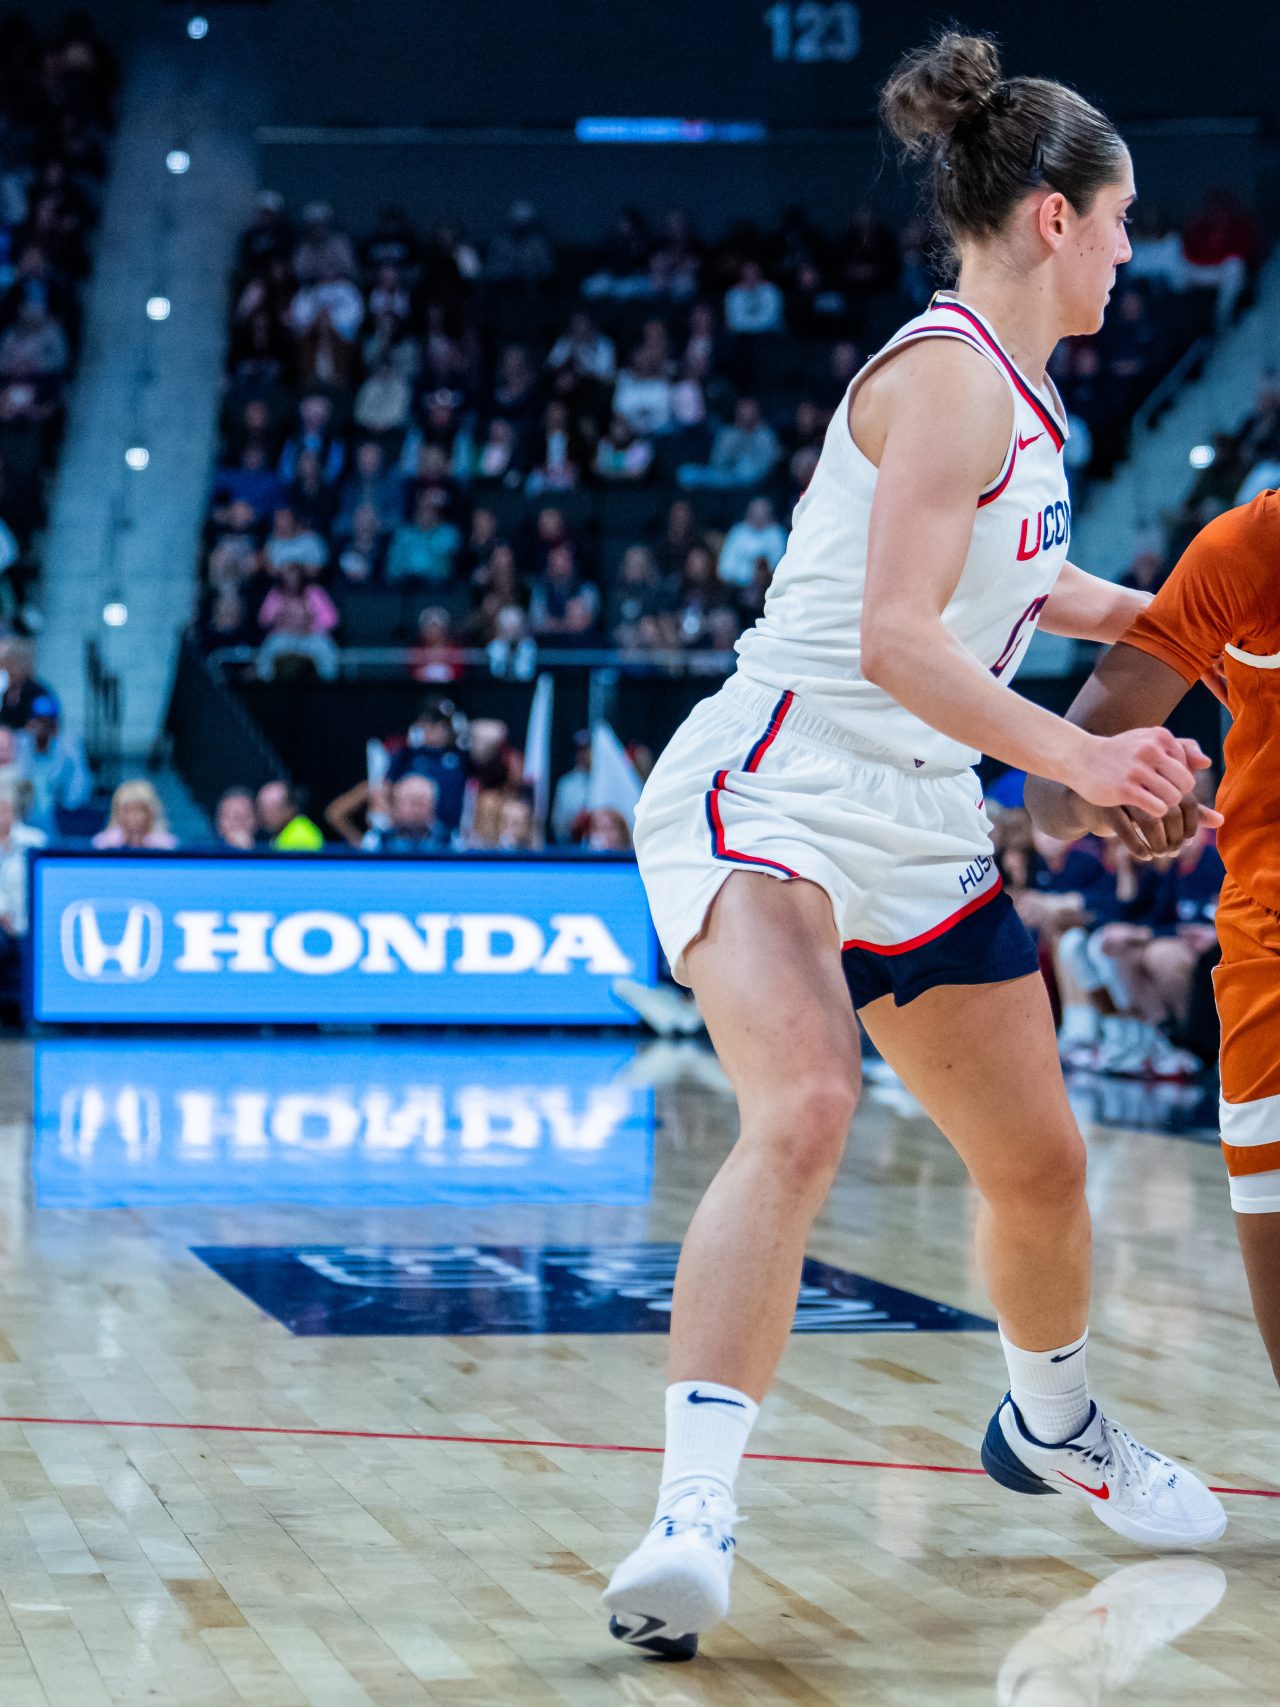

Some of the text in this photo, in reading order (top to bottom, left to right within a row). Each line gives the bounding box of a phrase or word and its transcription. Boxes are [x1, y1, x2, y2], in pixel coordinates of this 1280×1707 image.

[764, 2, 861, 62] 123
[959, 854, 992, 894] HUS
[174, 911, 633, 975] HONDA
